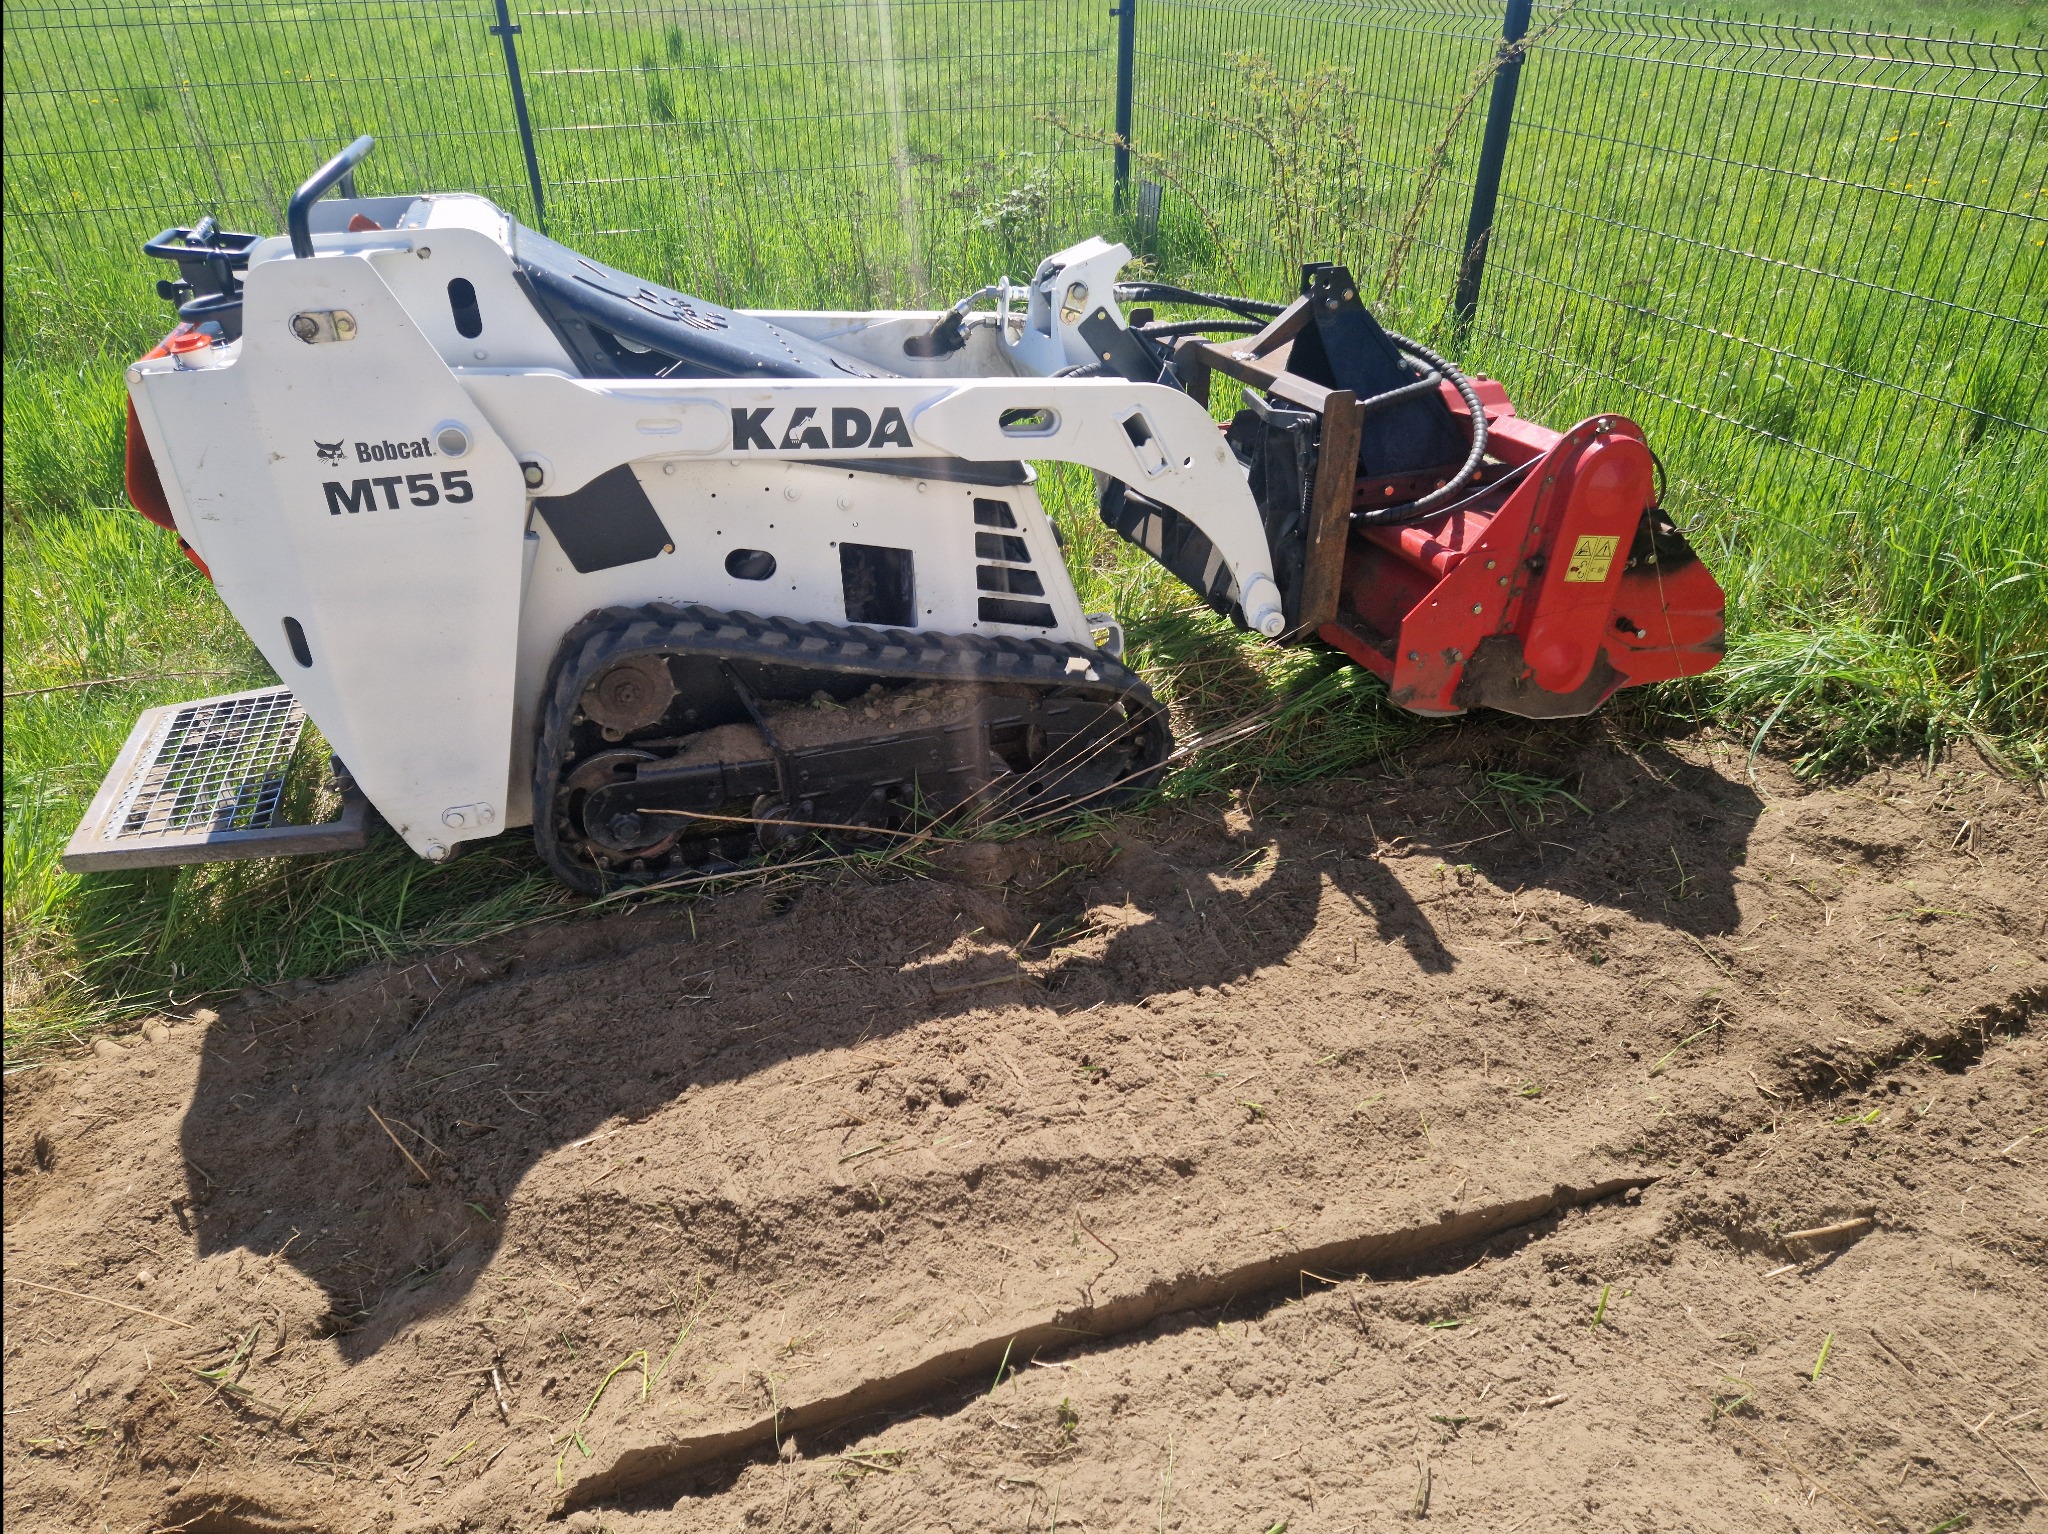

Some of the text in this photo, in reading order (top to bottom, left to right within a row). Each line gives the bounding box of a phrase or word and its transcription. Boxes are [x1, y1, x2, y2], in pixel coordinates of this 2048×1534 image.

[355, 437, 433, 463] Bobcat
[731, 407, 913, 450] KADA
[322, 470, 474, 515] MT55
